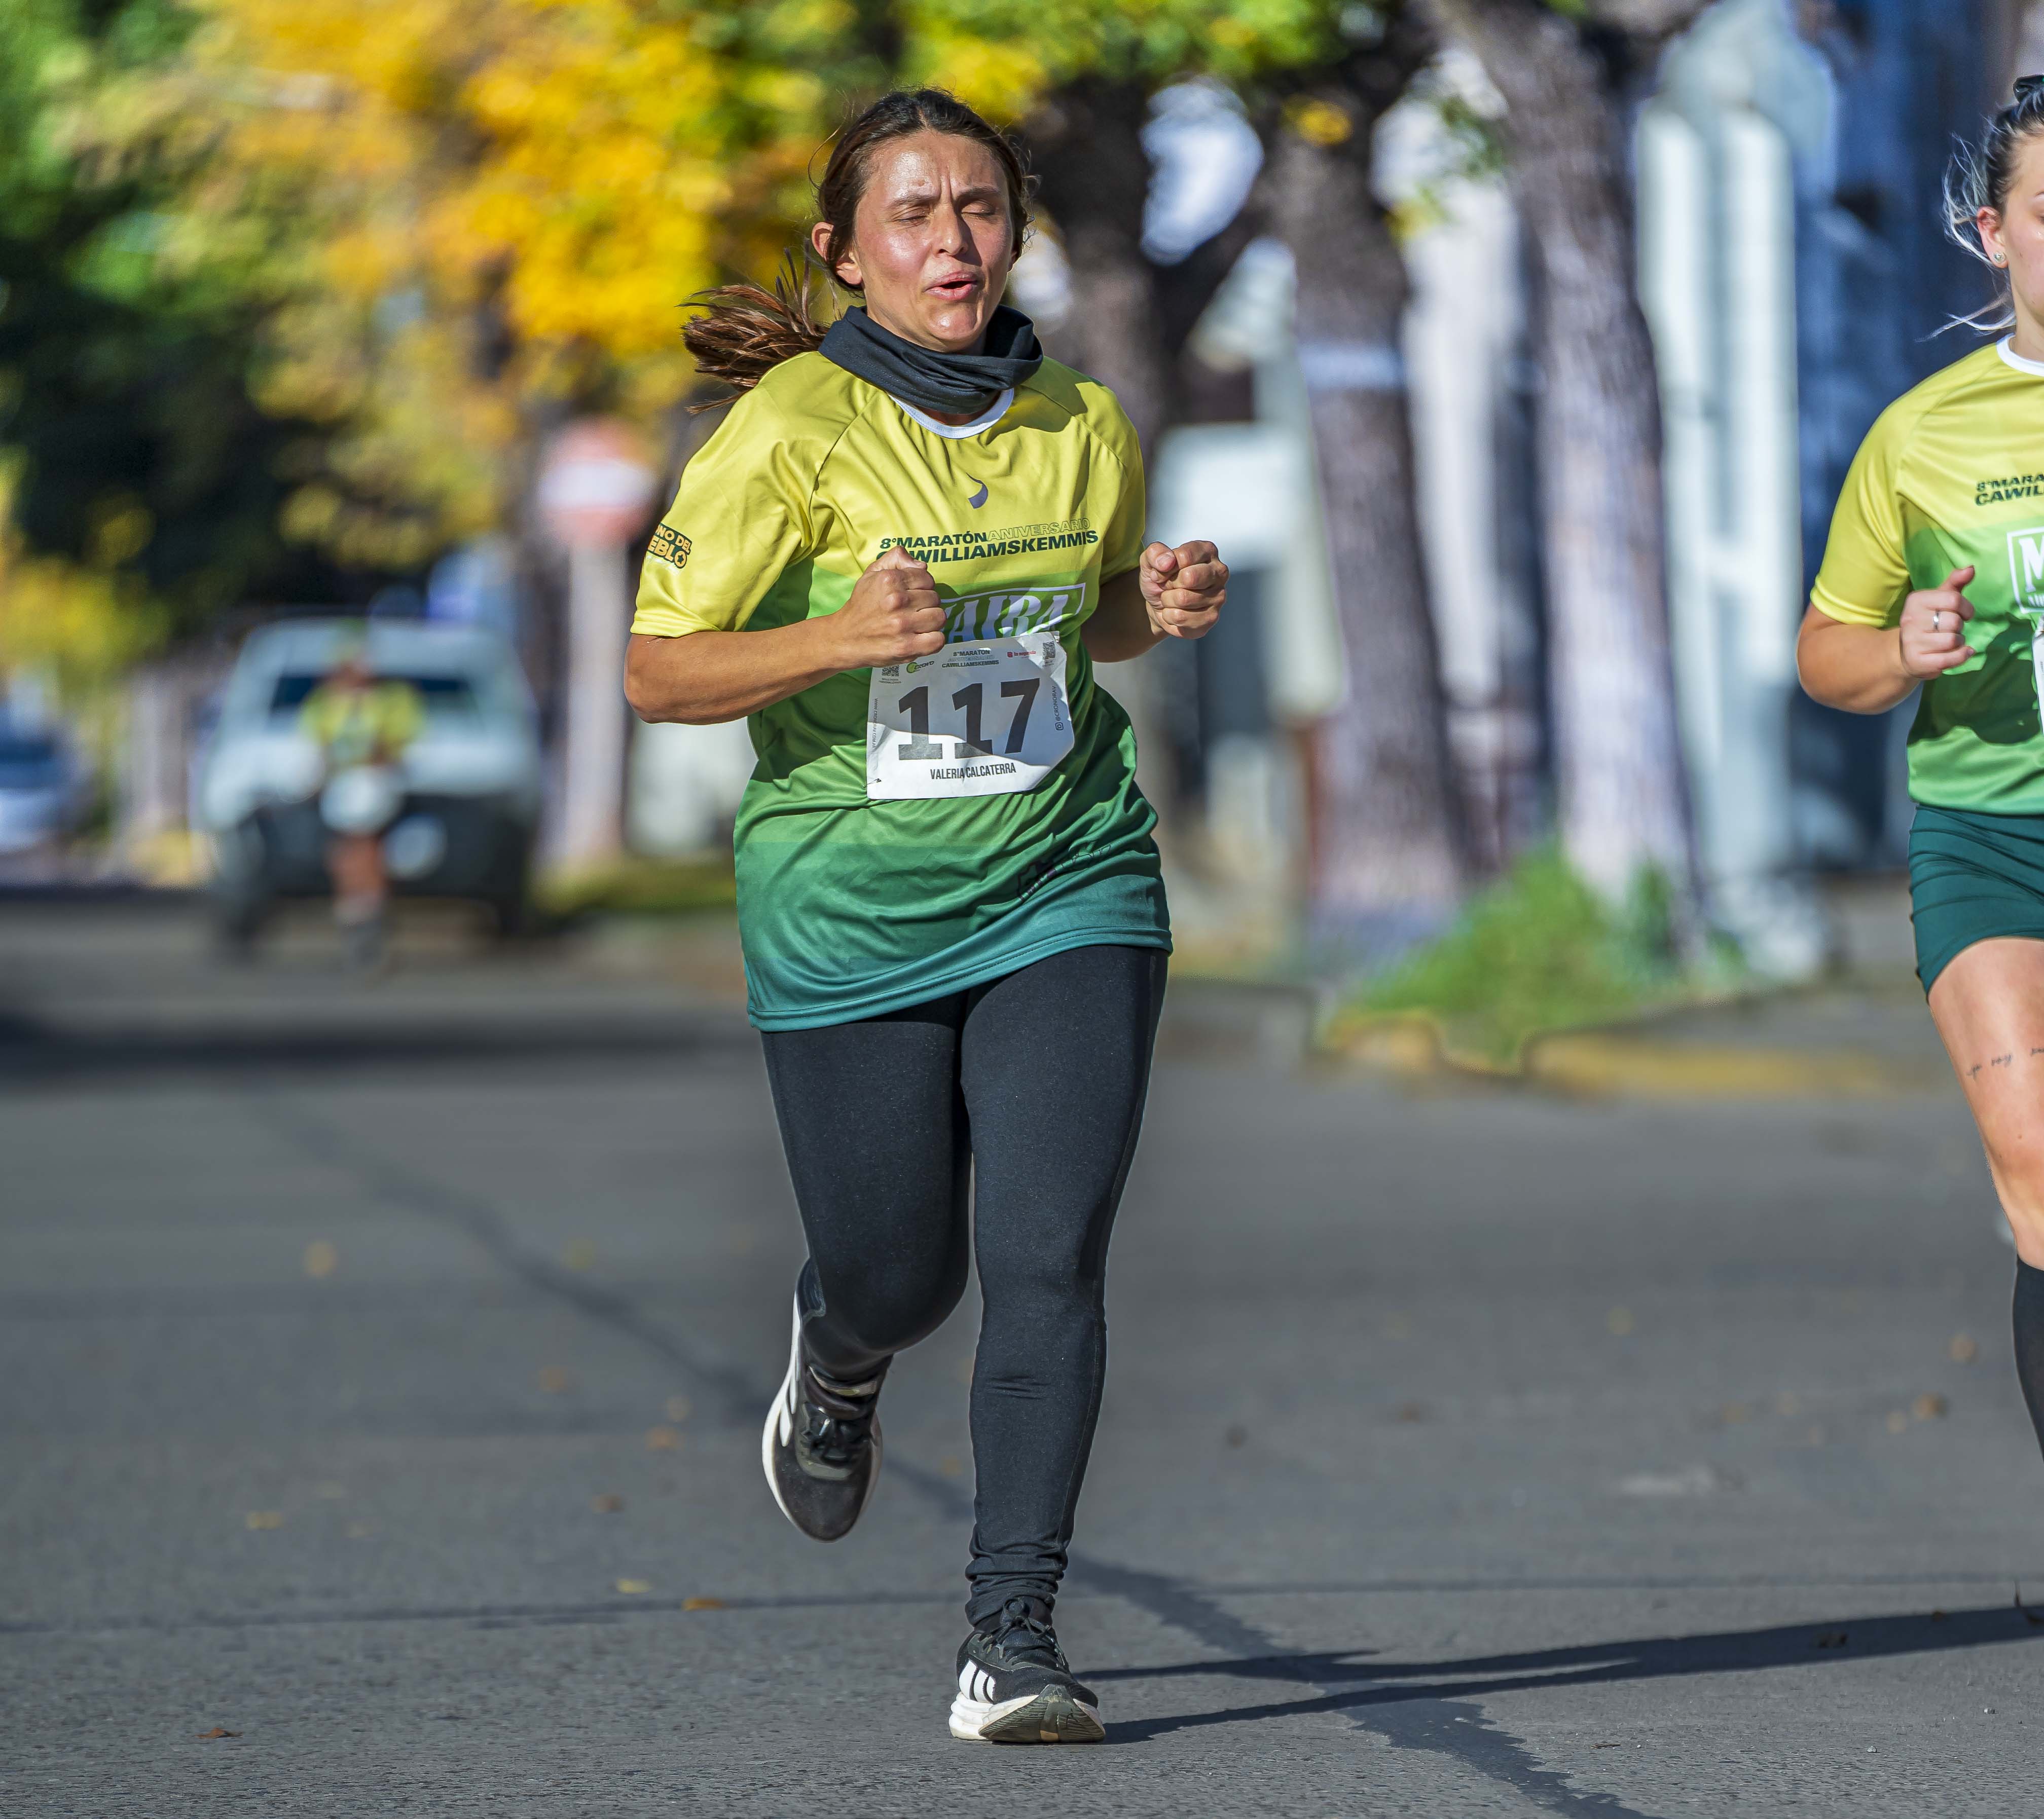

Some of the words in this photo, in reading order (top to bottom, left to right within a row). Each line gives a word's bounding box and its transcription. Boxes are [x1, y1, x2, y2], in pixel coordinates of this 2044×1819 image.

[675, 535, 691, 553] DEL
[876, 530, 1099, 564] WILLIAMSKEMMIS
[941, 659, 1000, 669] CAWILLIAMSKEMMIS
[898, 678, 1040, 760] 117
[930, 768, 965, 780] VALERIA
[965, 762, 1017, 778] CALCATERRA
